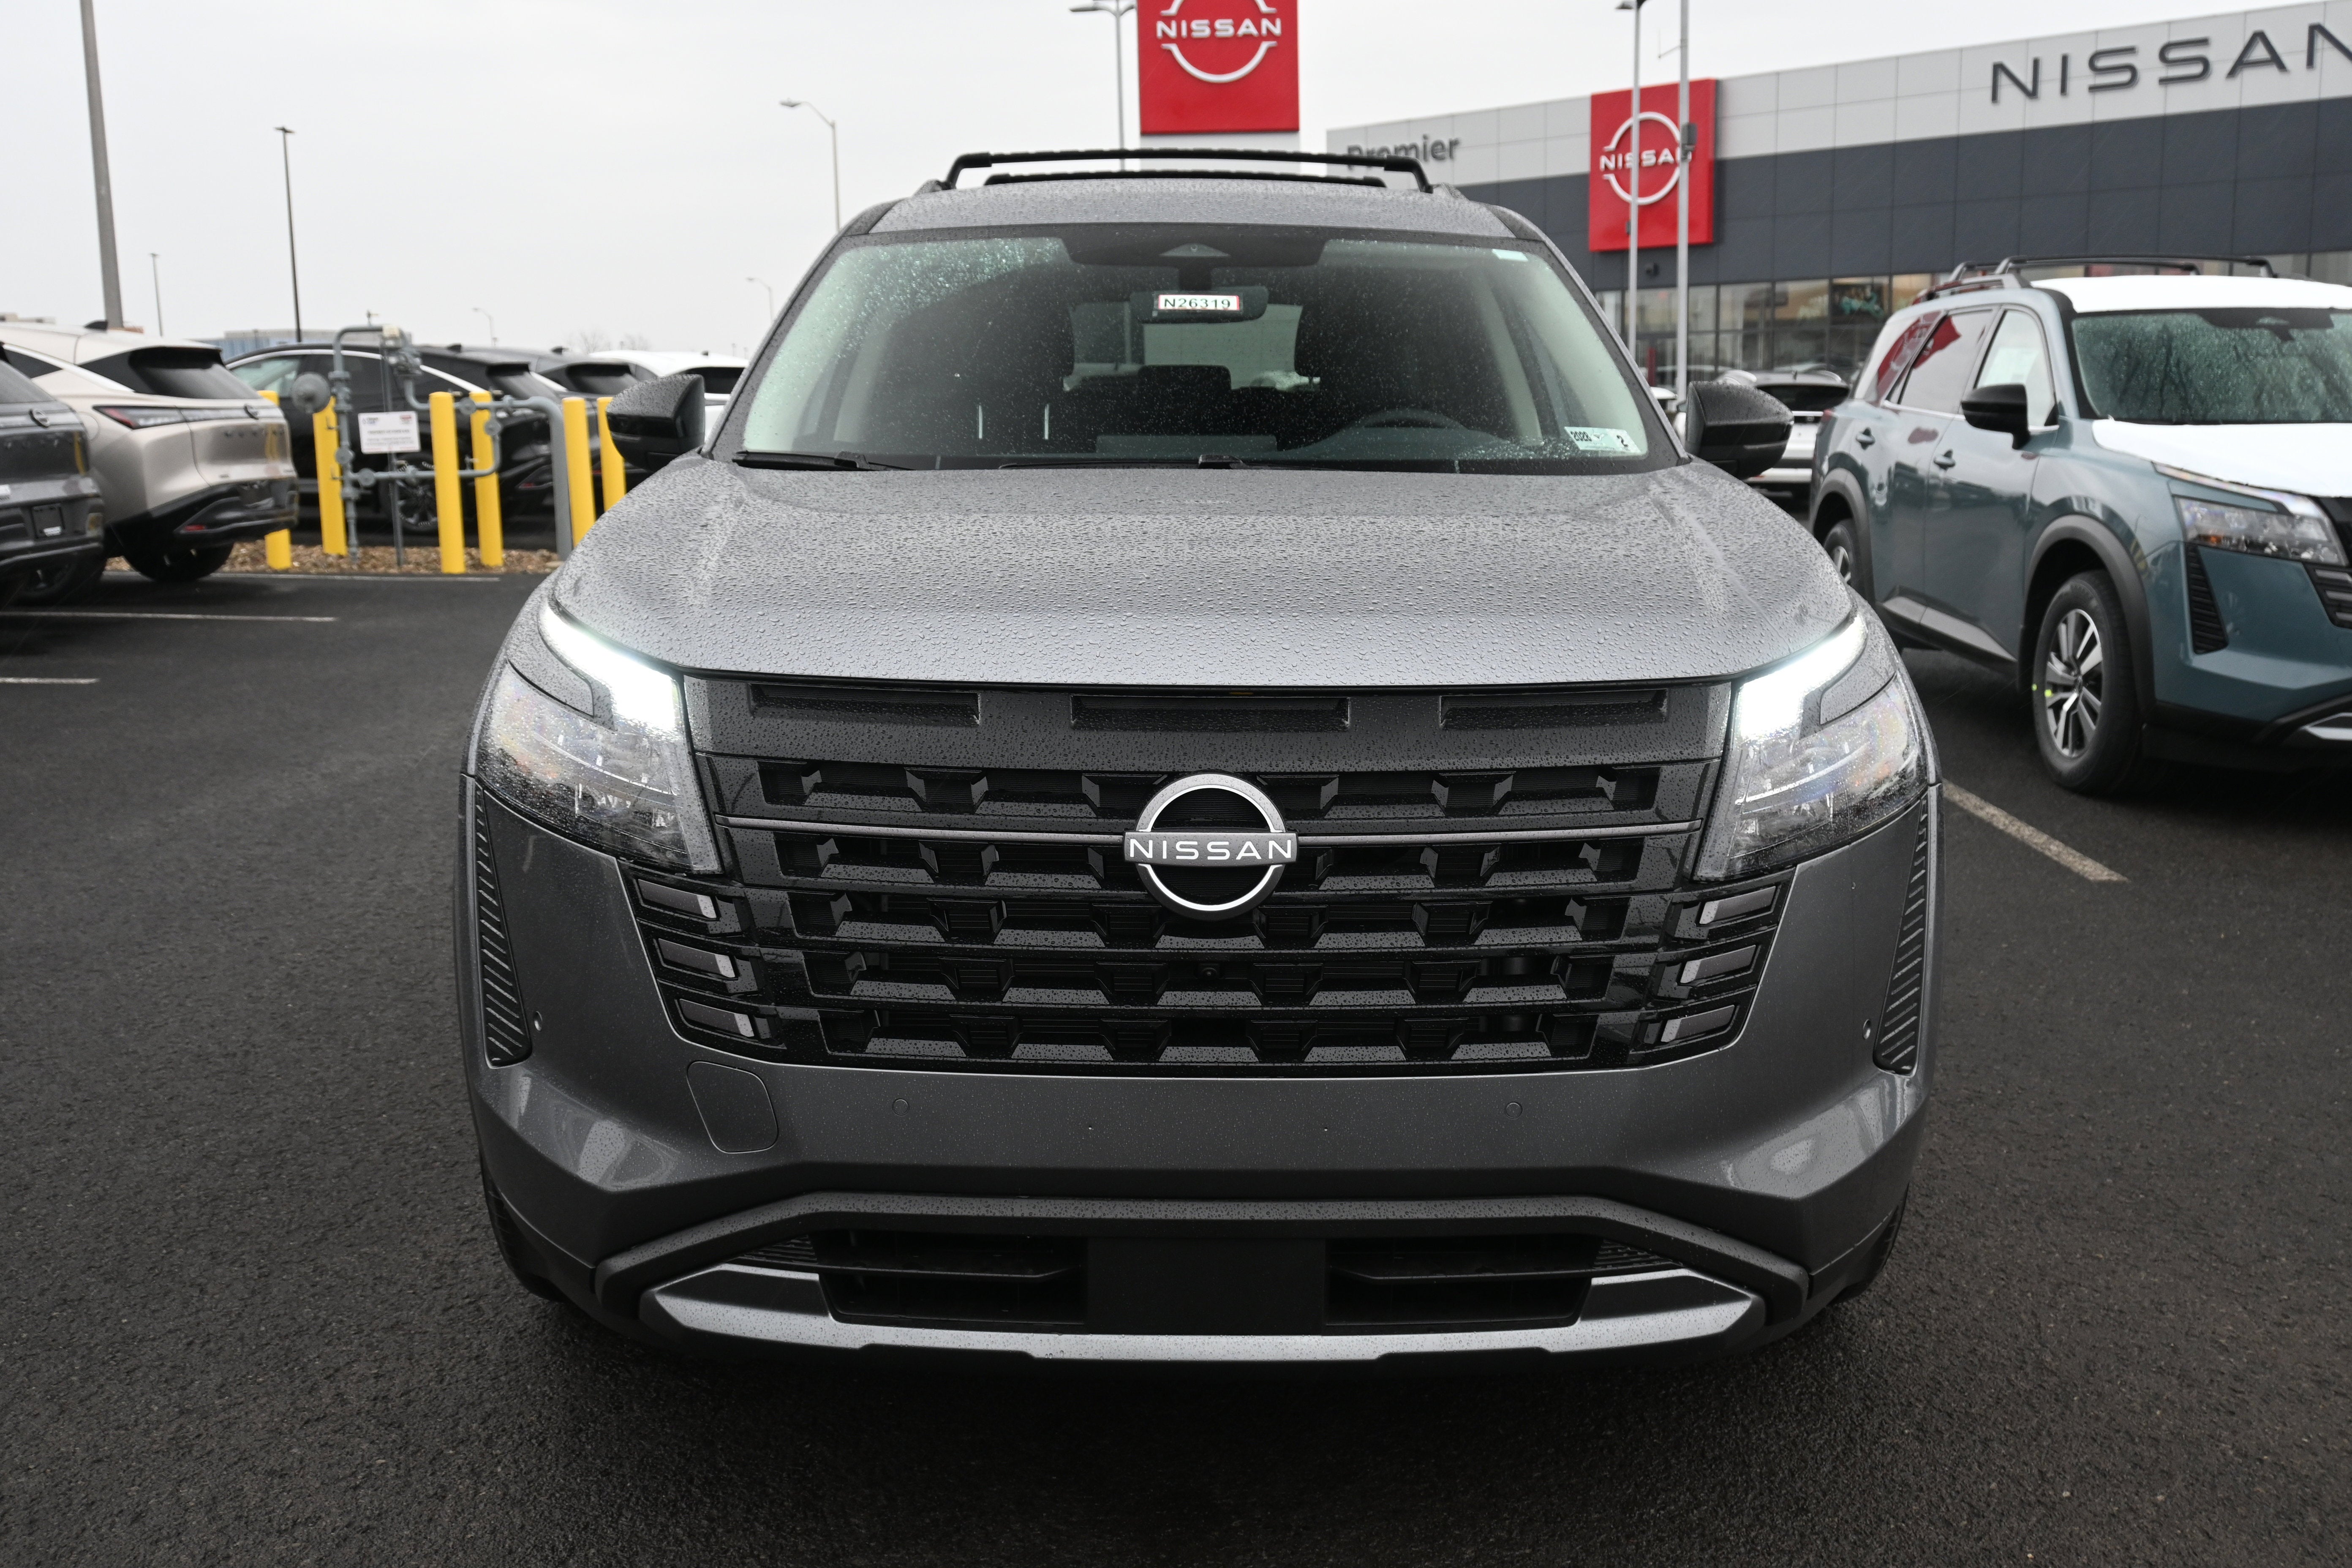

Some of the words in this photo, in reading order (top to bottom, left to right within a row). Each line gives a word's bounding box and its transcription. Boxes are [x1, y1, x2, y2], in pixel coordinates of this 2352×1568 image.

[1156, 18, 1282, 39] NISSAN
[1991, 23, 2352, 104] NISSAN
[1164, 298, 1230, 308] N26319
[1570, 431, 1592, 442] 2028
[1616, 435, 1629, 447] 2
[1130, 838, 1292, 860] NISSAN
